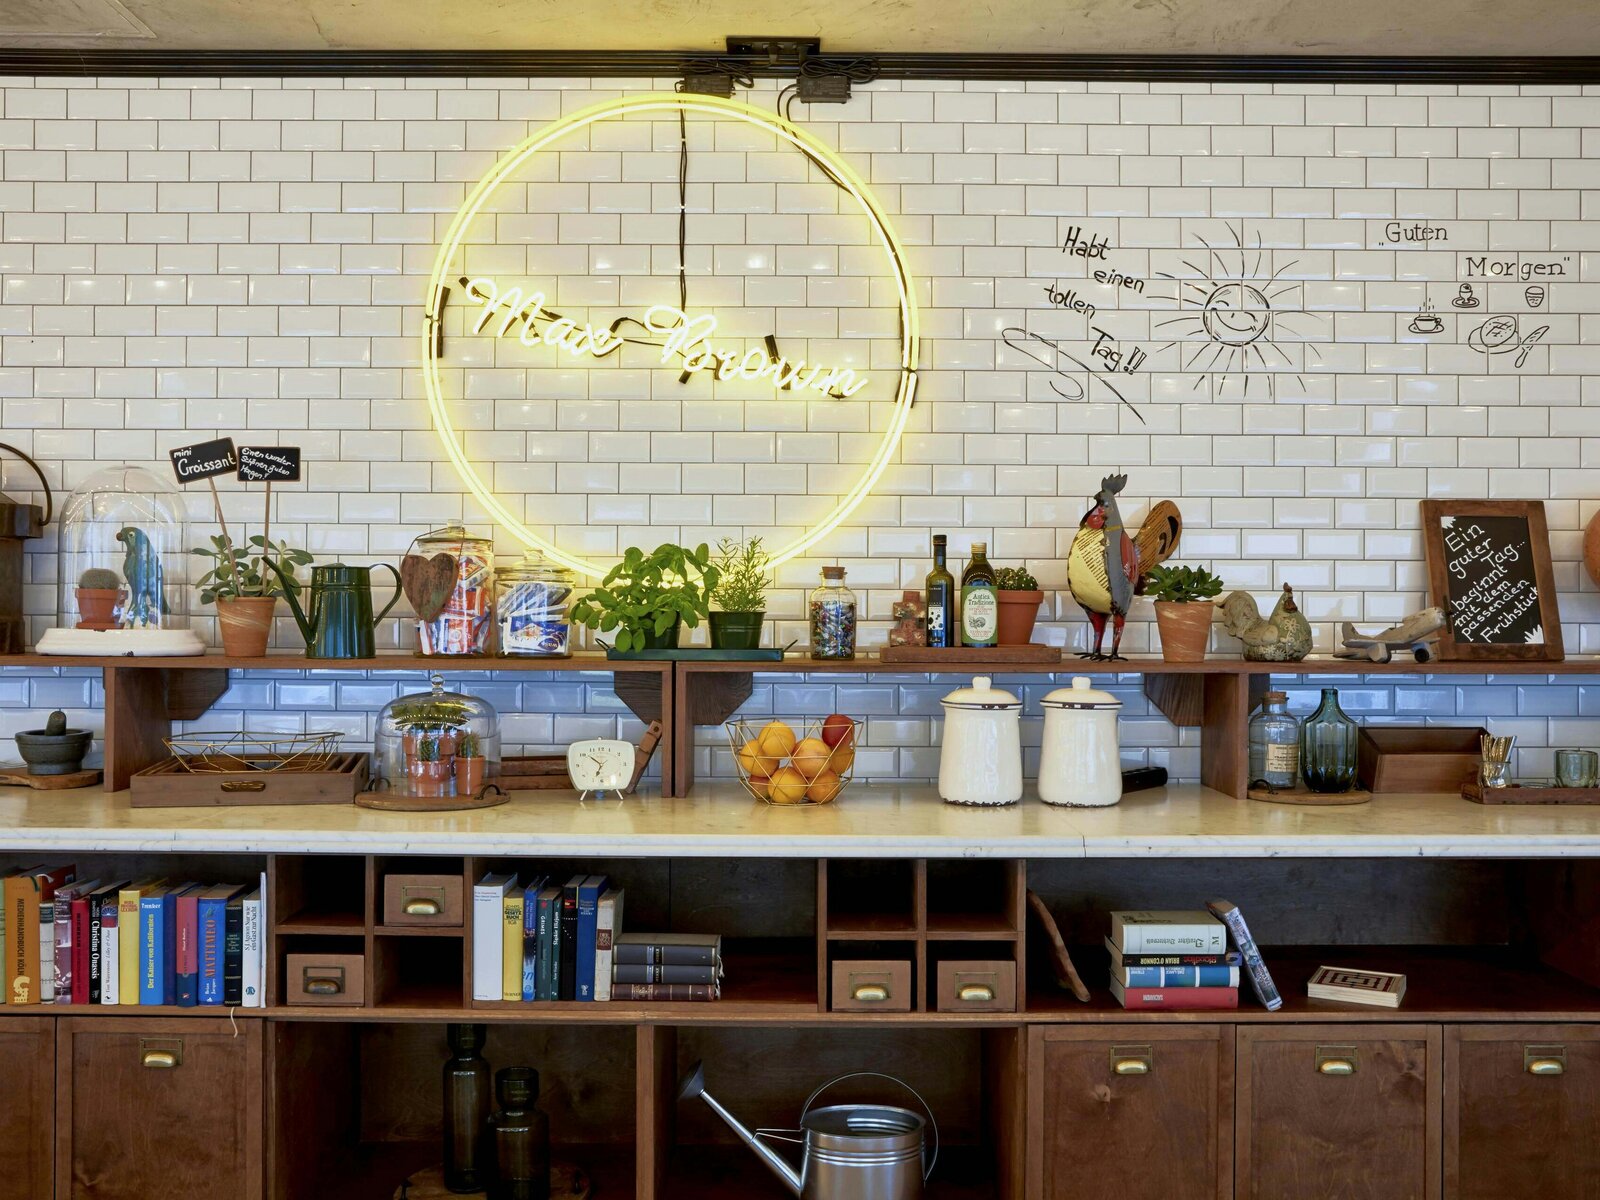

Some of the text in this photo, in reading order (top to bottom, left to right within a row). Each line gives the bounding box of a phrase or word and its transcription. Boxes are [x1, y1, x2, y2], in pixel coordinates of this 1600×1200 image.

[1062, 226, 1111, 260] Habt
[1093, 269, 1145, 293] einen
[1044, 284, 1096, 319] tollen
[464, 277, 868, 398] Max Brown
[173, 447, 192, 459] mini
[1444, 523, 1485, 552] Ein
[1449, 538, 1492, 580] guter
[1454, 580, 1512, 628] mit dem
[1461, 579, 1530, 643] passenden
[1479, 586, 1539, 644] Frühstück
[91, 920, 100, 952] Christina
[205, 919, 216, 977] MATTIMEO
[91, 953, 100, 979] Onassis
[1165, 957, 1180, 965] BRIAN
